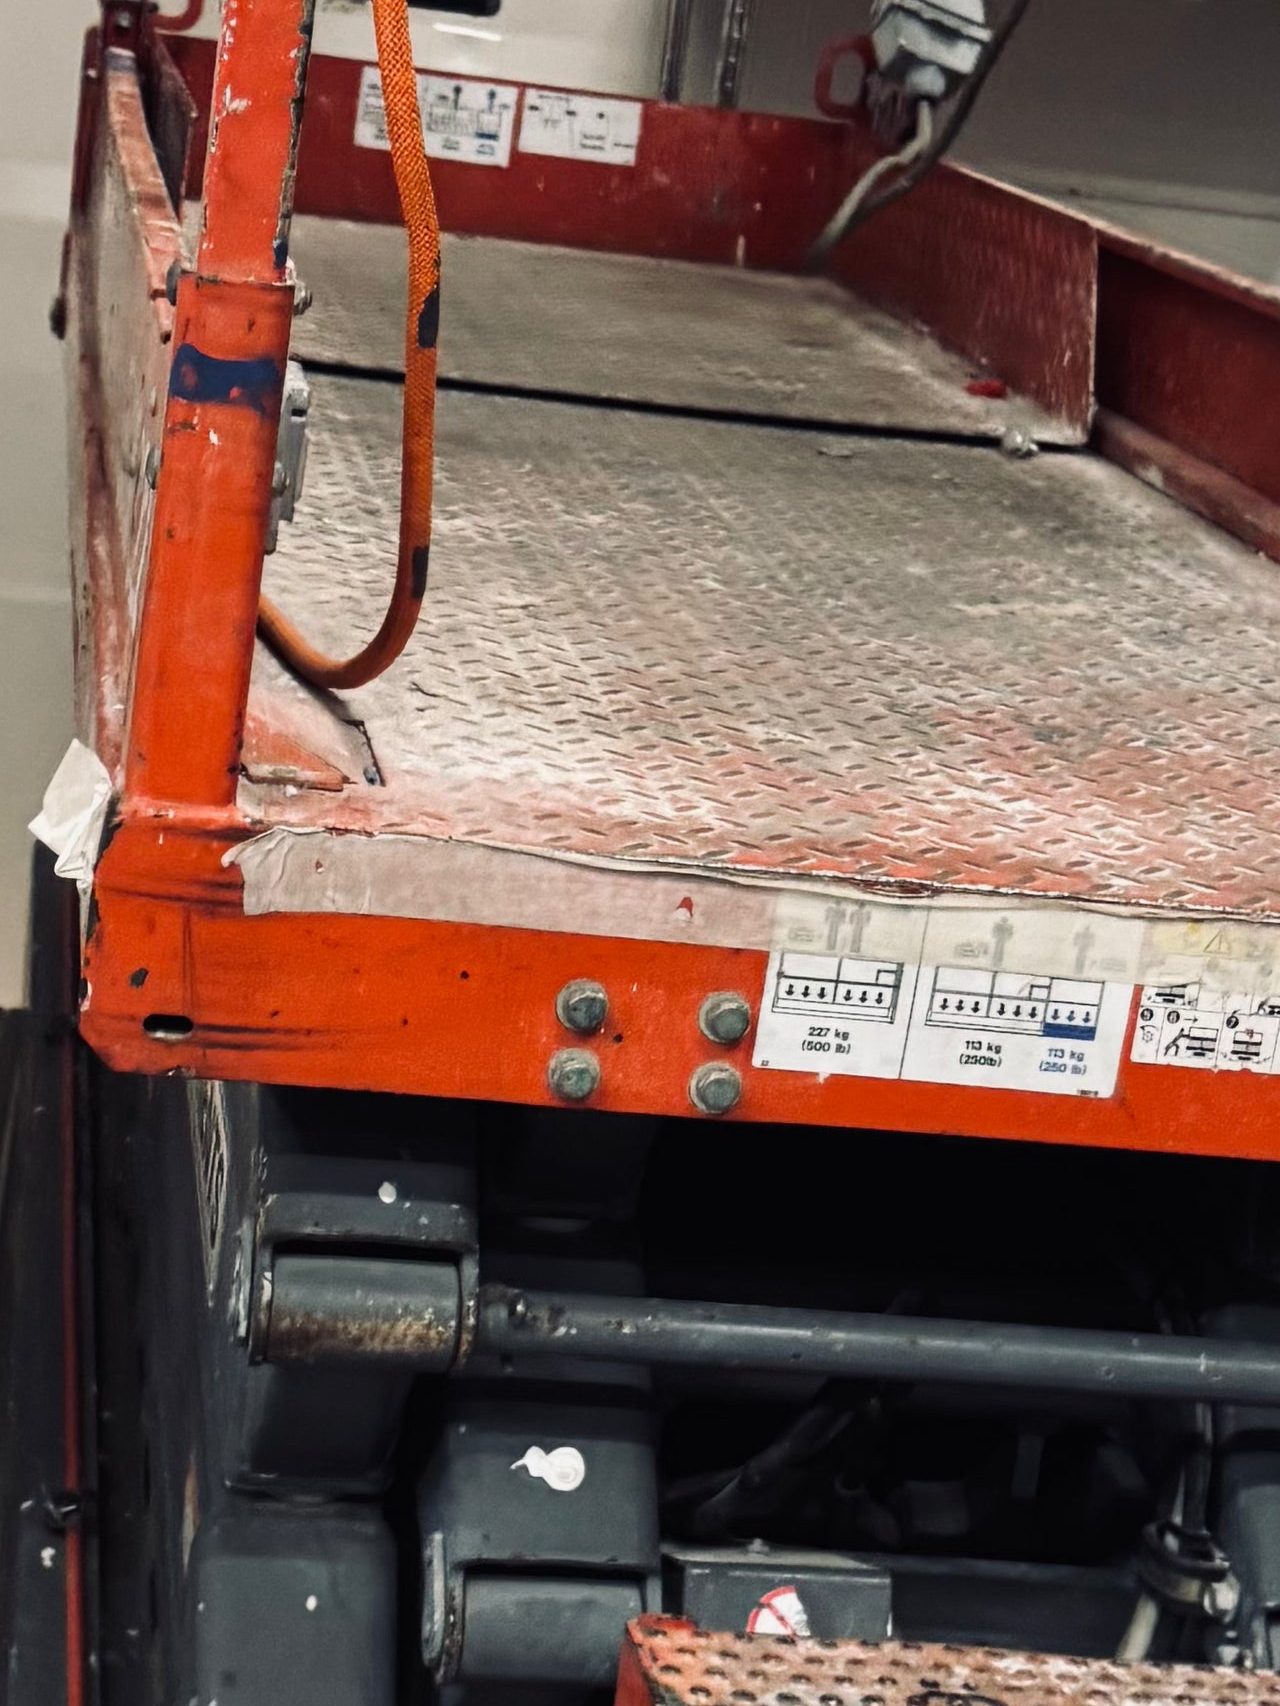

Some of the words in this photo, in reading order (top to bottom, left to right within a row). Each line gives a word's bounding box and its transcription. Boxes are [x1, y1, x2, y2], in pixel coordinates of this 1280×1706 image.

[808, 1026, 831, 1037] 227
[834, 1028, 850, 1041] kg
[801, 1039, 831, 1053] (500
[986, 1041, 1002, 1054] kg
[1069, 1049, 1085, 1063] kg
